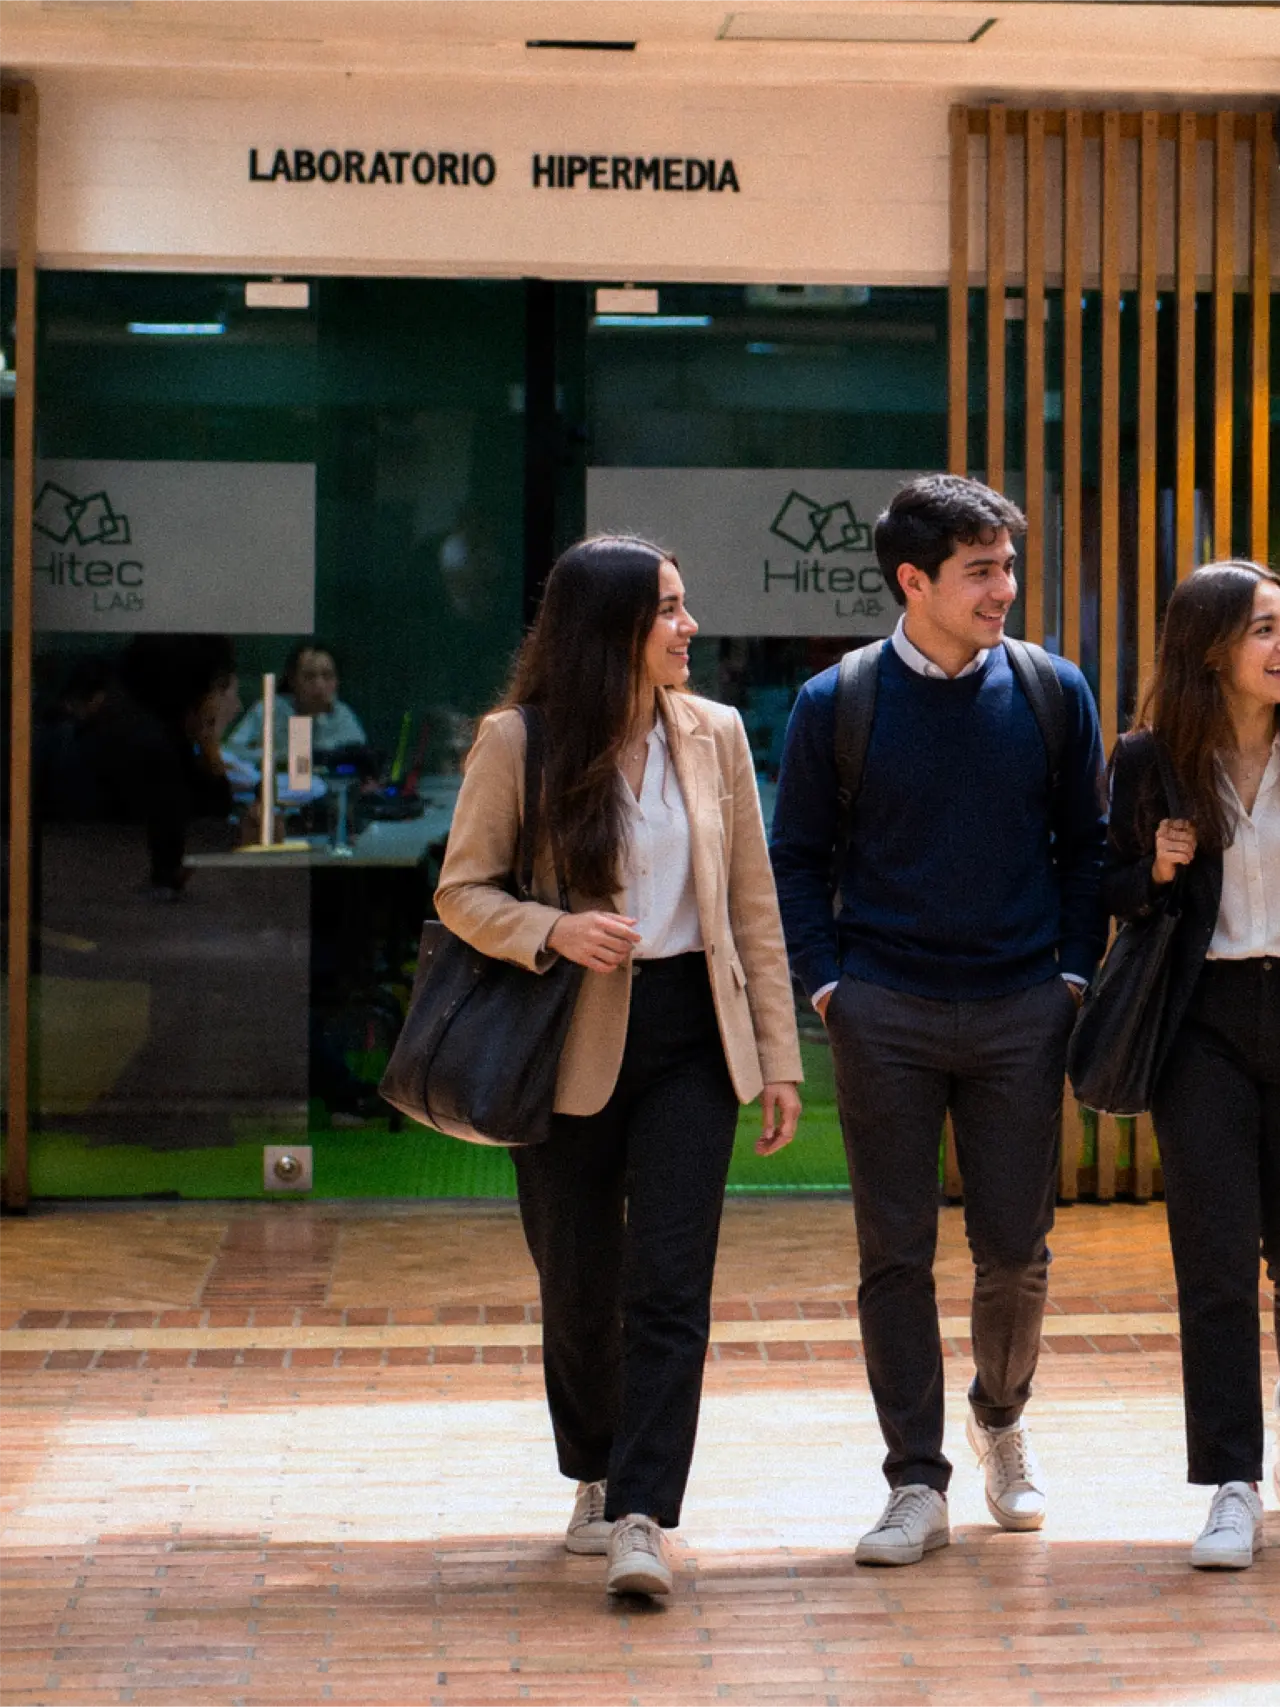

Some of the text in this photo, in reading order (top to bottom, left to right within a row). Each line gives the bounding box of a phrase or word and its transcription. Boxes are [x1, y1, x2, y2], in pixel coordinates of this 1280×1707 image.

[248, 148, 740, 192] LABORATORIO HIPERMEDIA
[764, 559, 883, 593] Hitec
[835, 600, 884, 617] LAB
